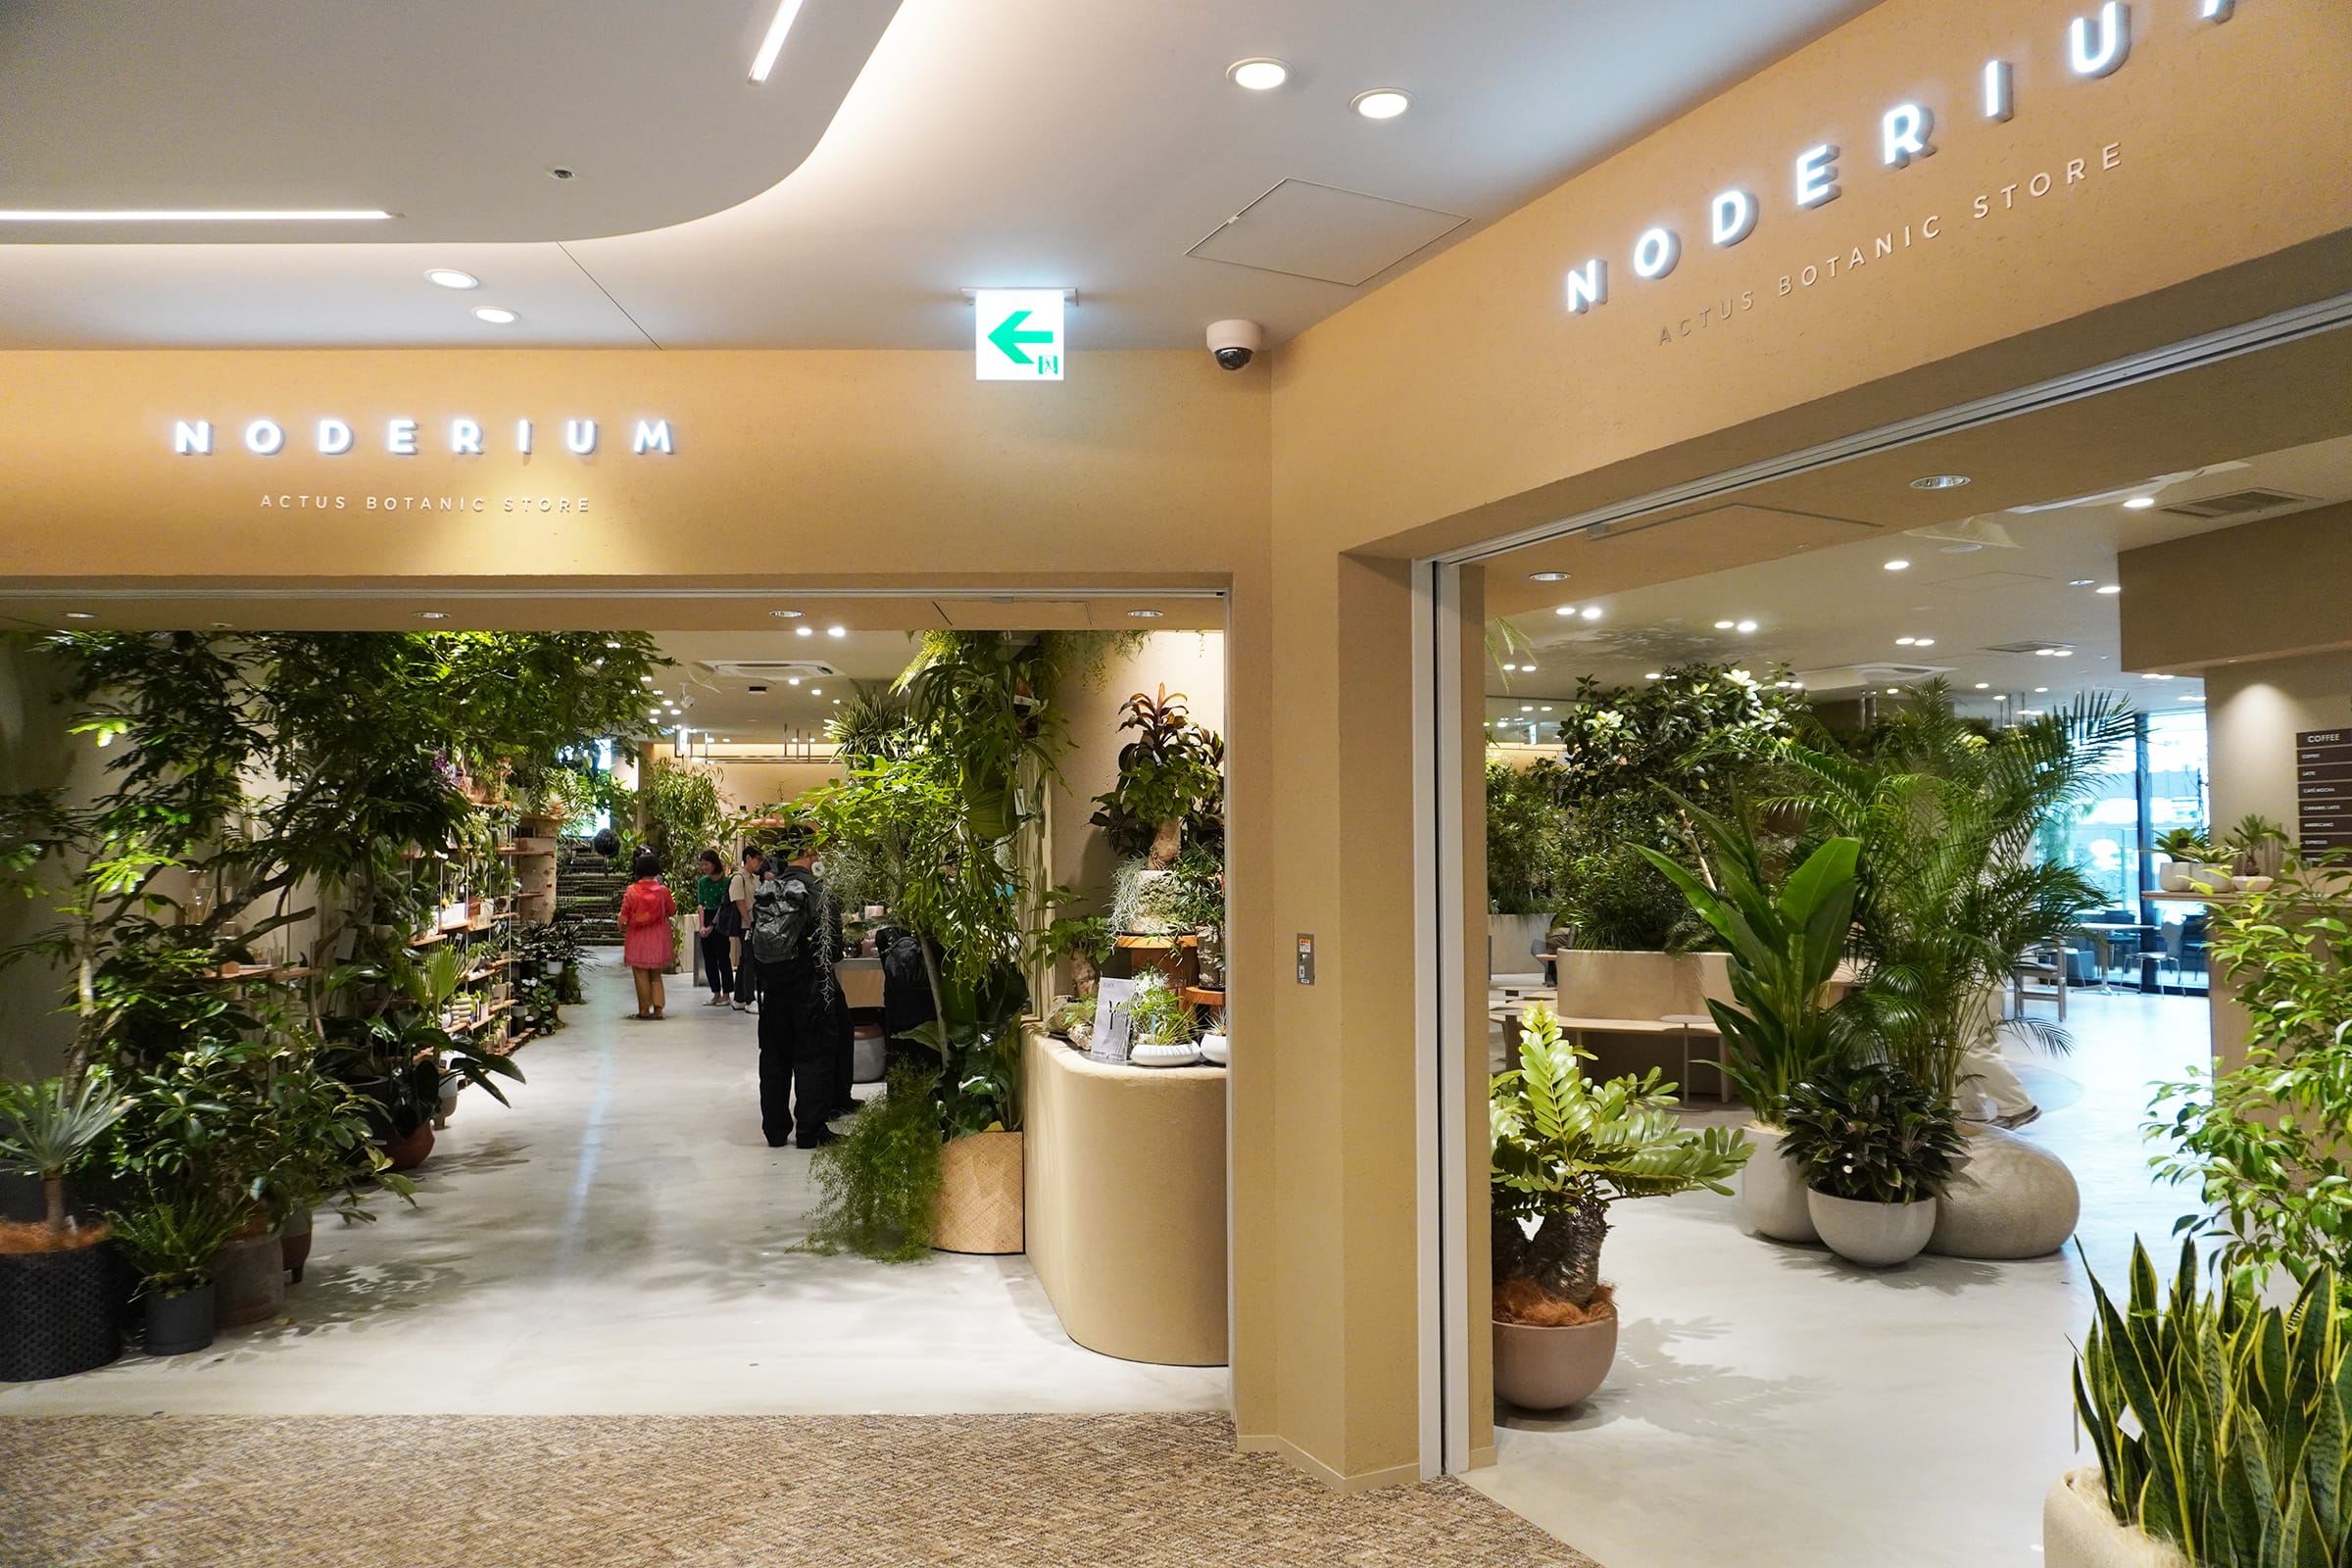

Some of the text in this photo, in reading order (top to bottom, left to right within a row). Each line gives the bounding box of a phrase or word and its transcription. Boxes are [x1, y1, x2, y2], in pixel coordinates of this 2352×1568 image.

[1567, 0, 2233, 314] NODERIU
[1657, 142, 2123, 346] ACTUS BOTANIC STORE
[174, 418, 675, 456] NODERIUM
[260, 493, 591, 514] ACTUS BOTANIC STORE
[2307, 733, 2340, 743] COFFEE
